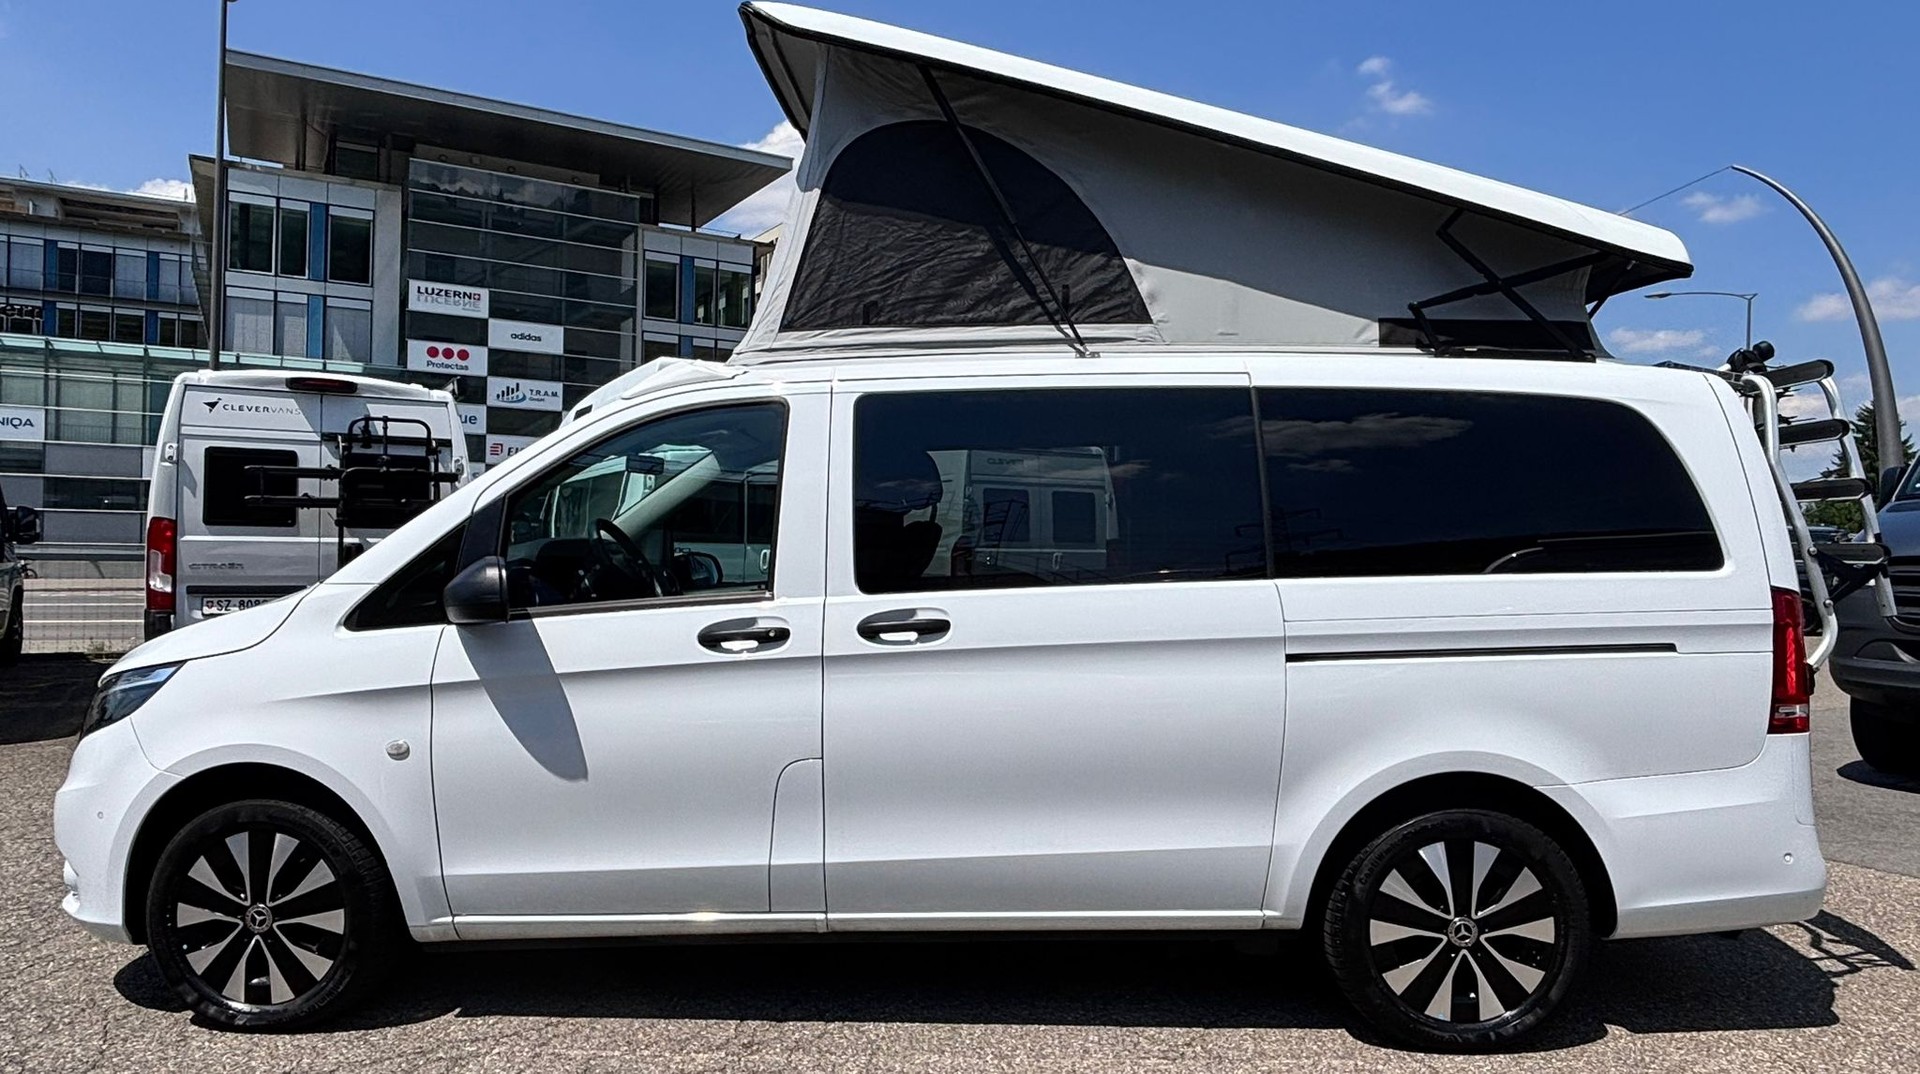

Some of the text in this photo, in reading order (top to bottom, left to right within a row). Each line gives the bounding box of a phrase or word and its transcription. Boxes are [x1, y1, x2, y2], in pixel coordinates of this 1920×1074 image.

[417, 286, 473, 300] LUZERN
[510, 332, 542, 342] adidas
[426, 360, 469, 371] Protectas
[528, 388, 560, 398] T.R.A.M.
[222, 403, 301, 415] CLEVERVANS
